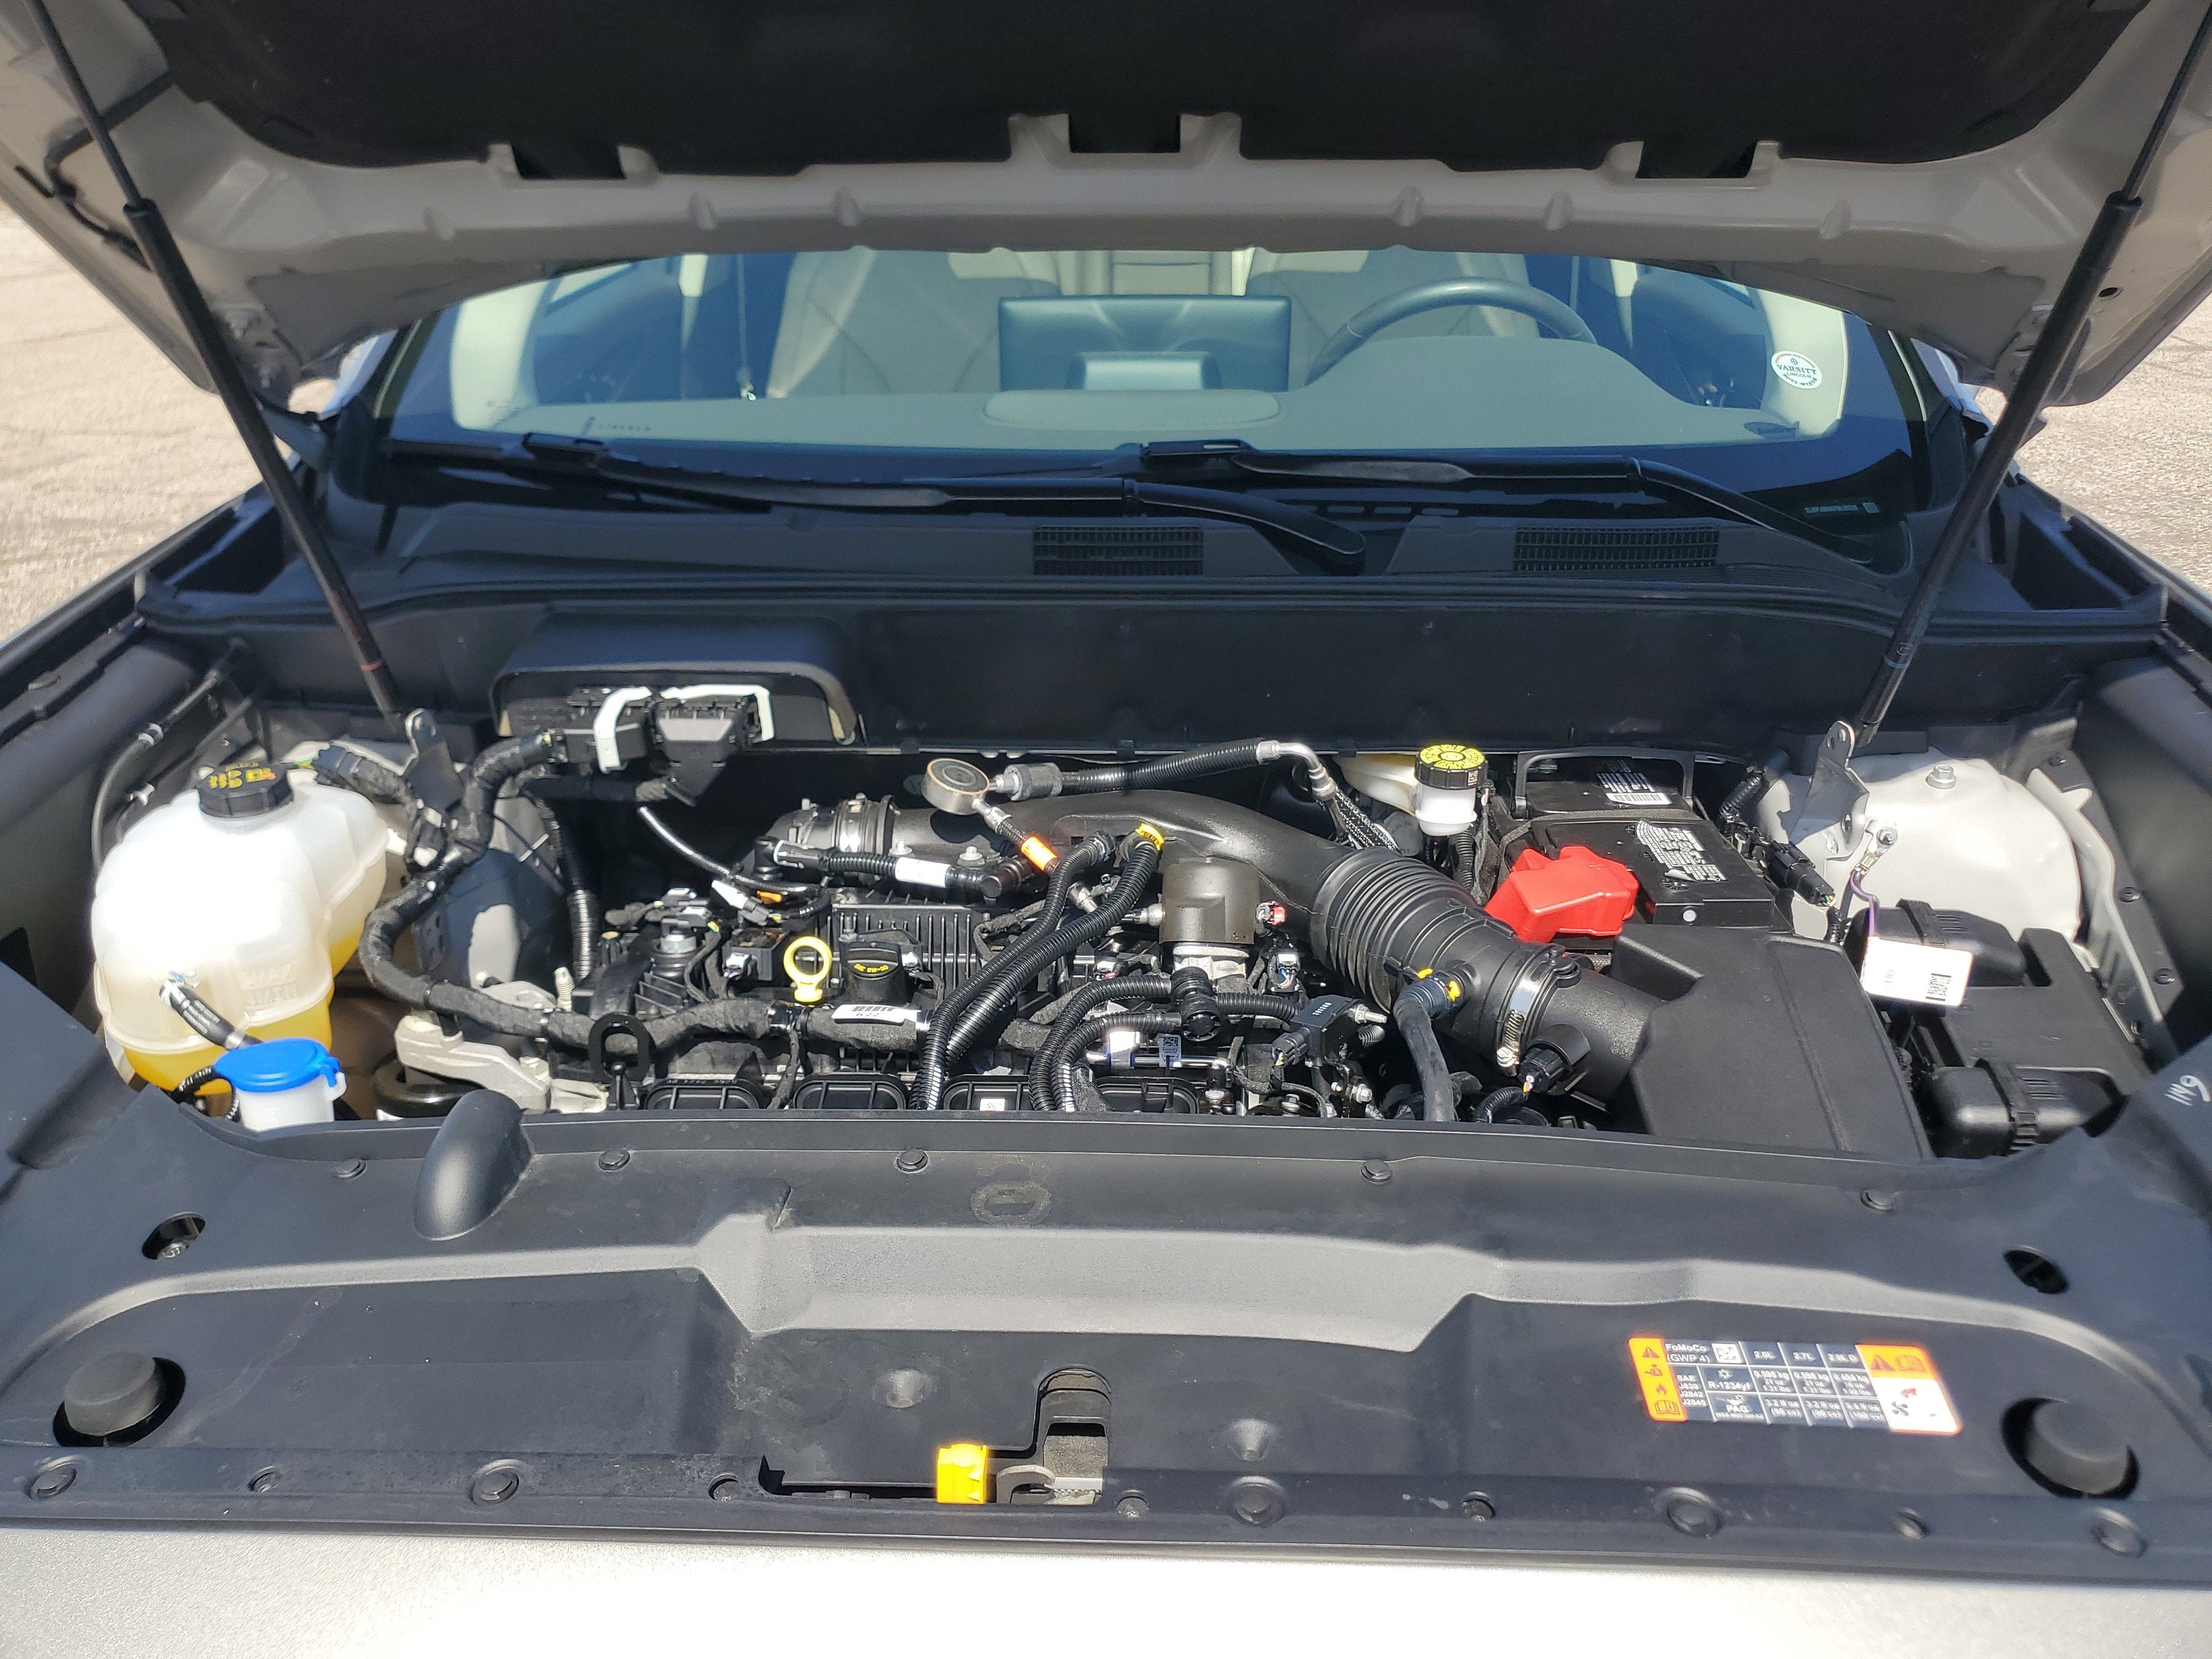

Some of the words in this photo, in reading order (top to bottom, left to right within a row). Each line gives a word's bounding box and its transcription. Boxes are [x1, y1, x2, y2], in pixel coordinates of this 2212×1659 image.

[1776, 364, 1817, 375] VARSITY
[1665, 1344, 1707, 1352] FoMoCo
[1667, 1354, 1697, 1362] (GWP
[1699, 1355, 1710, 1363] 4)
[1708, 1381, 1751, 1391] R-1234yf
[1726, 1404, 1749, 1413] PAG
